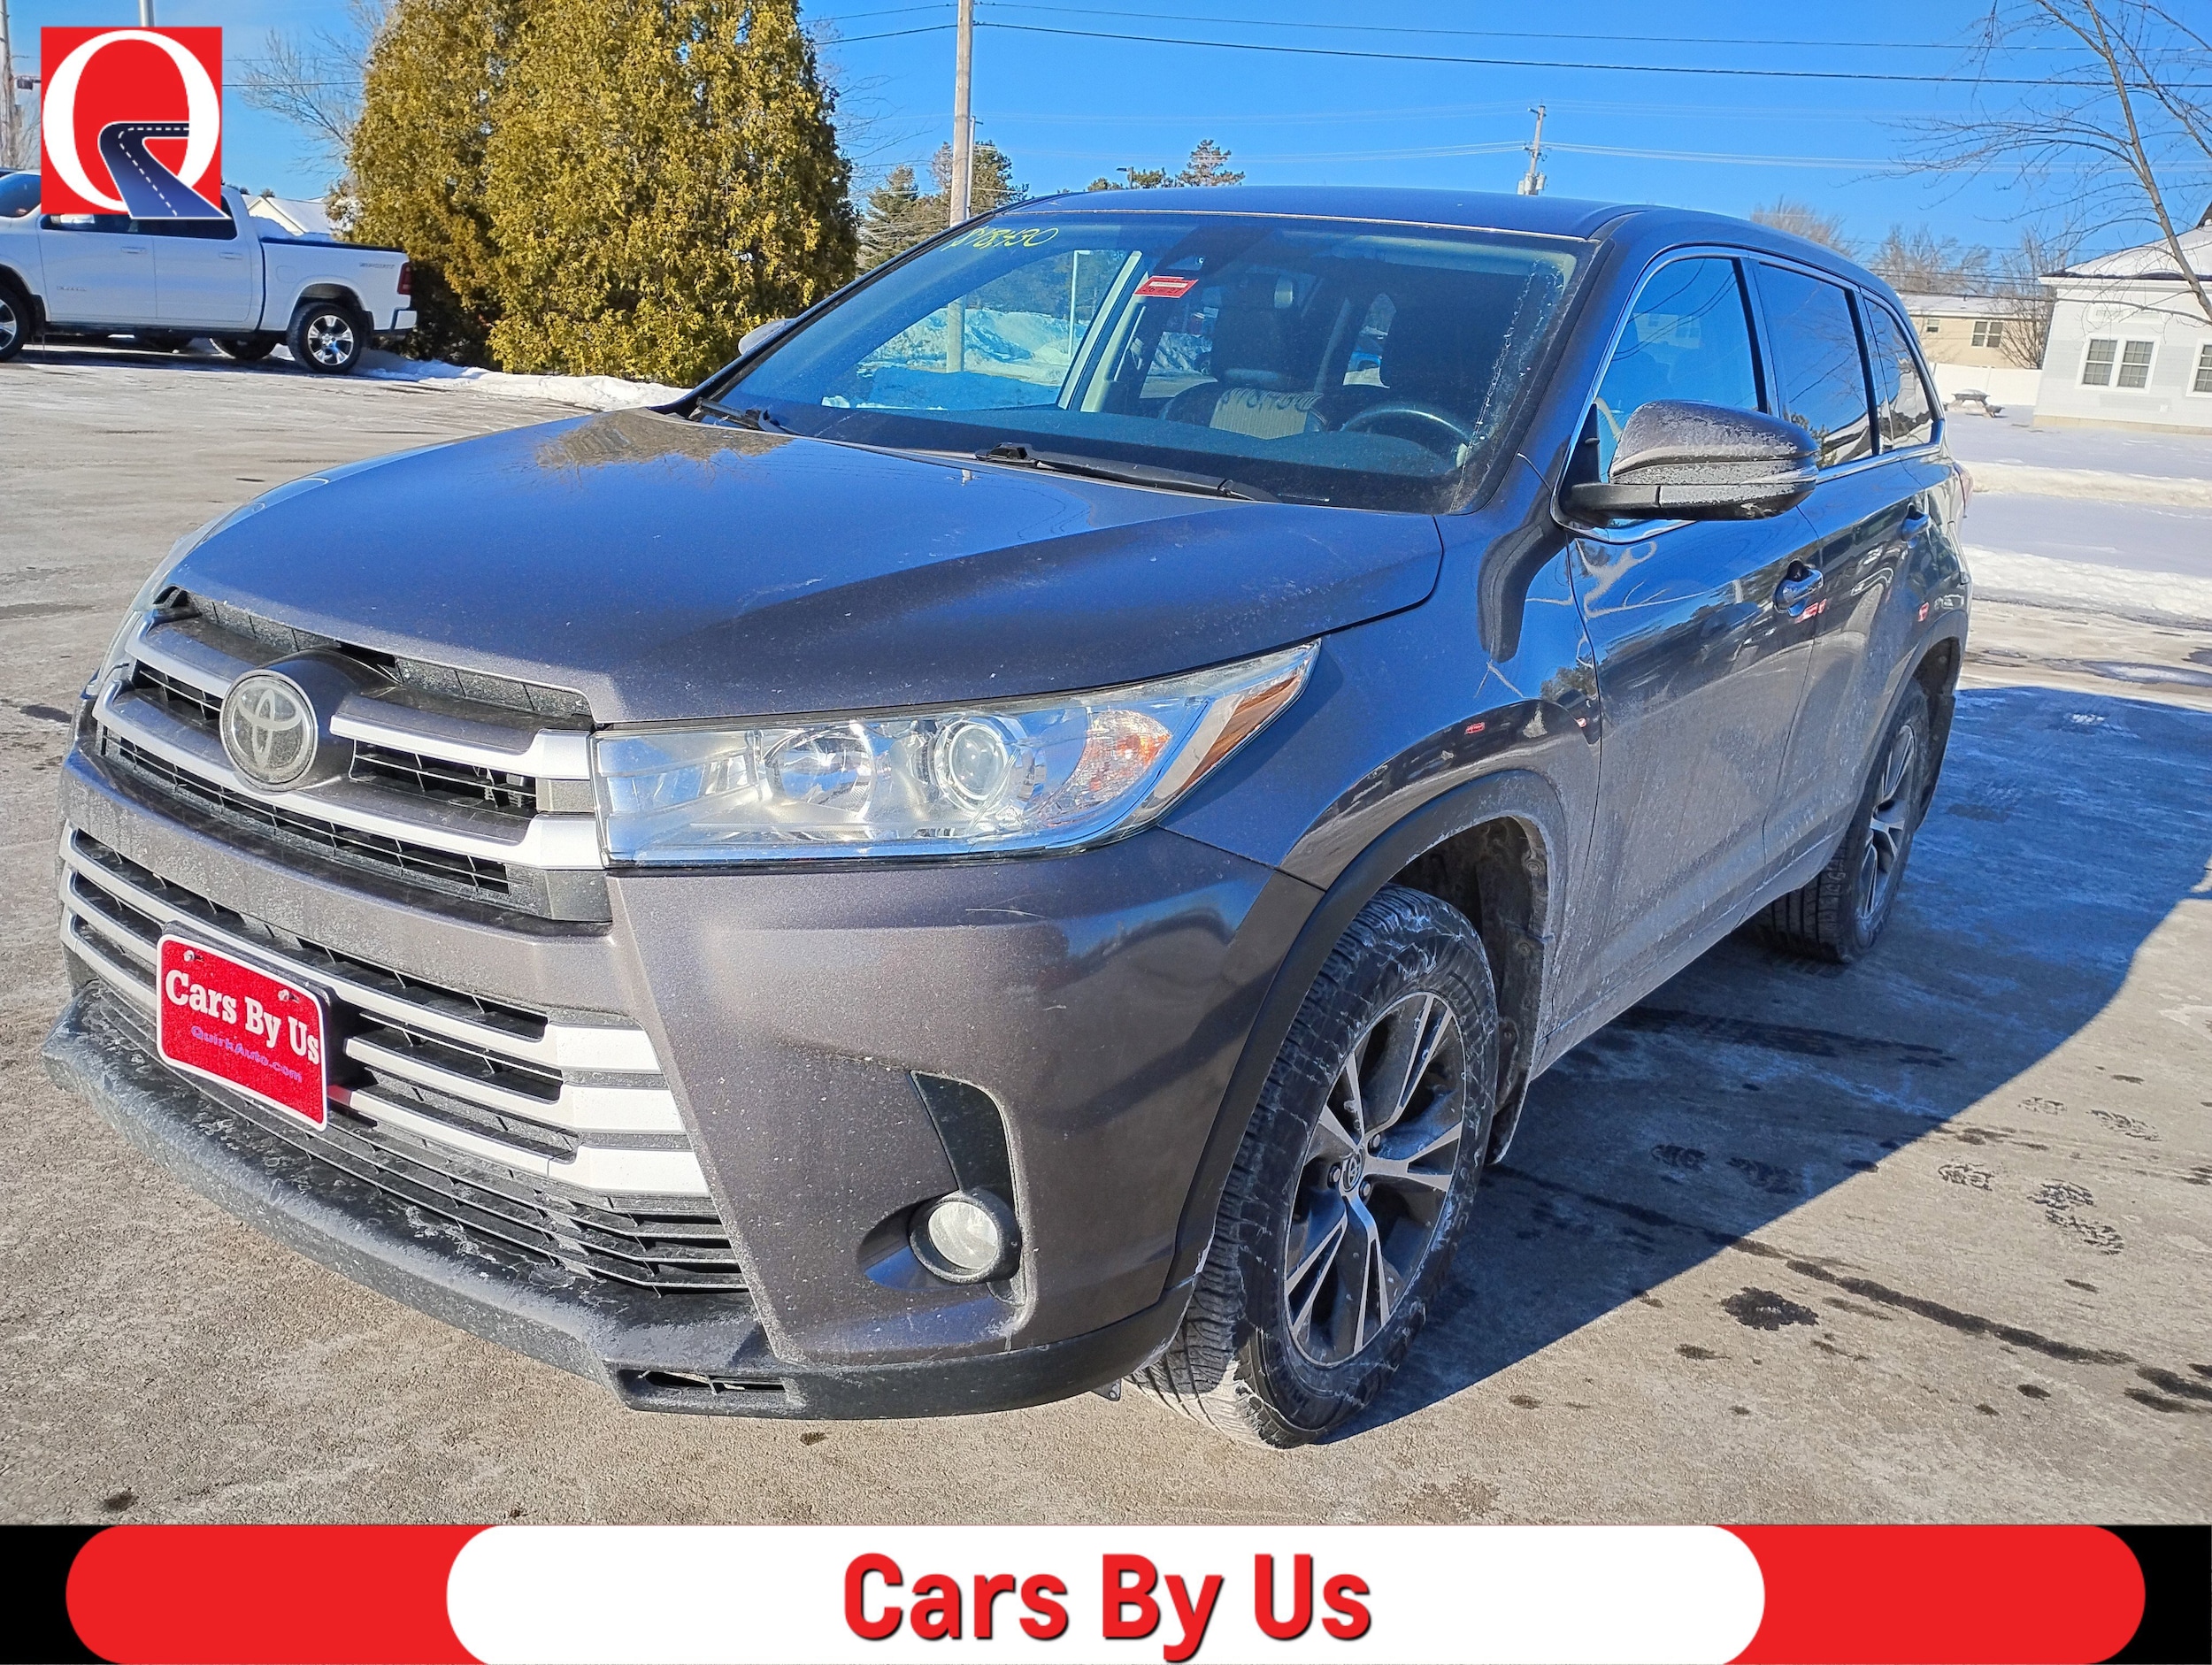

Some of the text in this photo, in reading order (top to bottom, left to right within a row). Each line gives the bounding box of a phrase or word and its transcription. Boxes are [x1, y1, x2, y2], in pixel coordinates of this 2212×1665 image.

[165, 969, 319, 1065] Cars By Us
[190, 1025, 303, 1083] QuirkAuto.com
